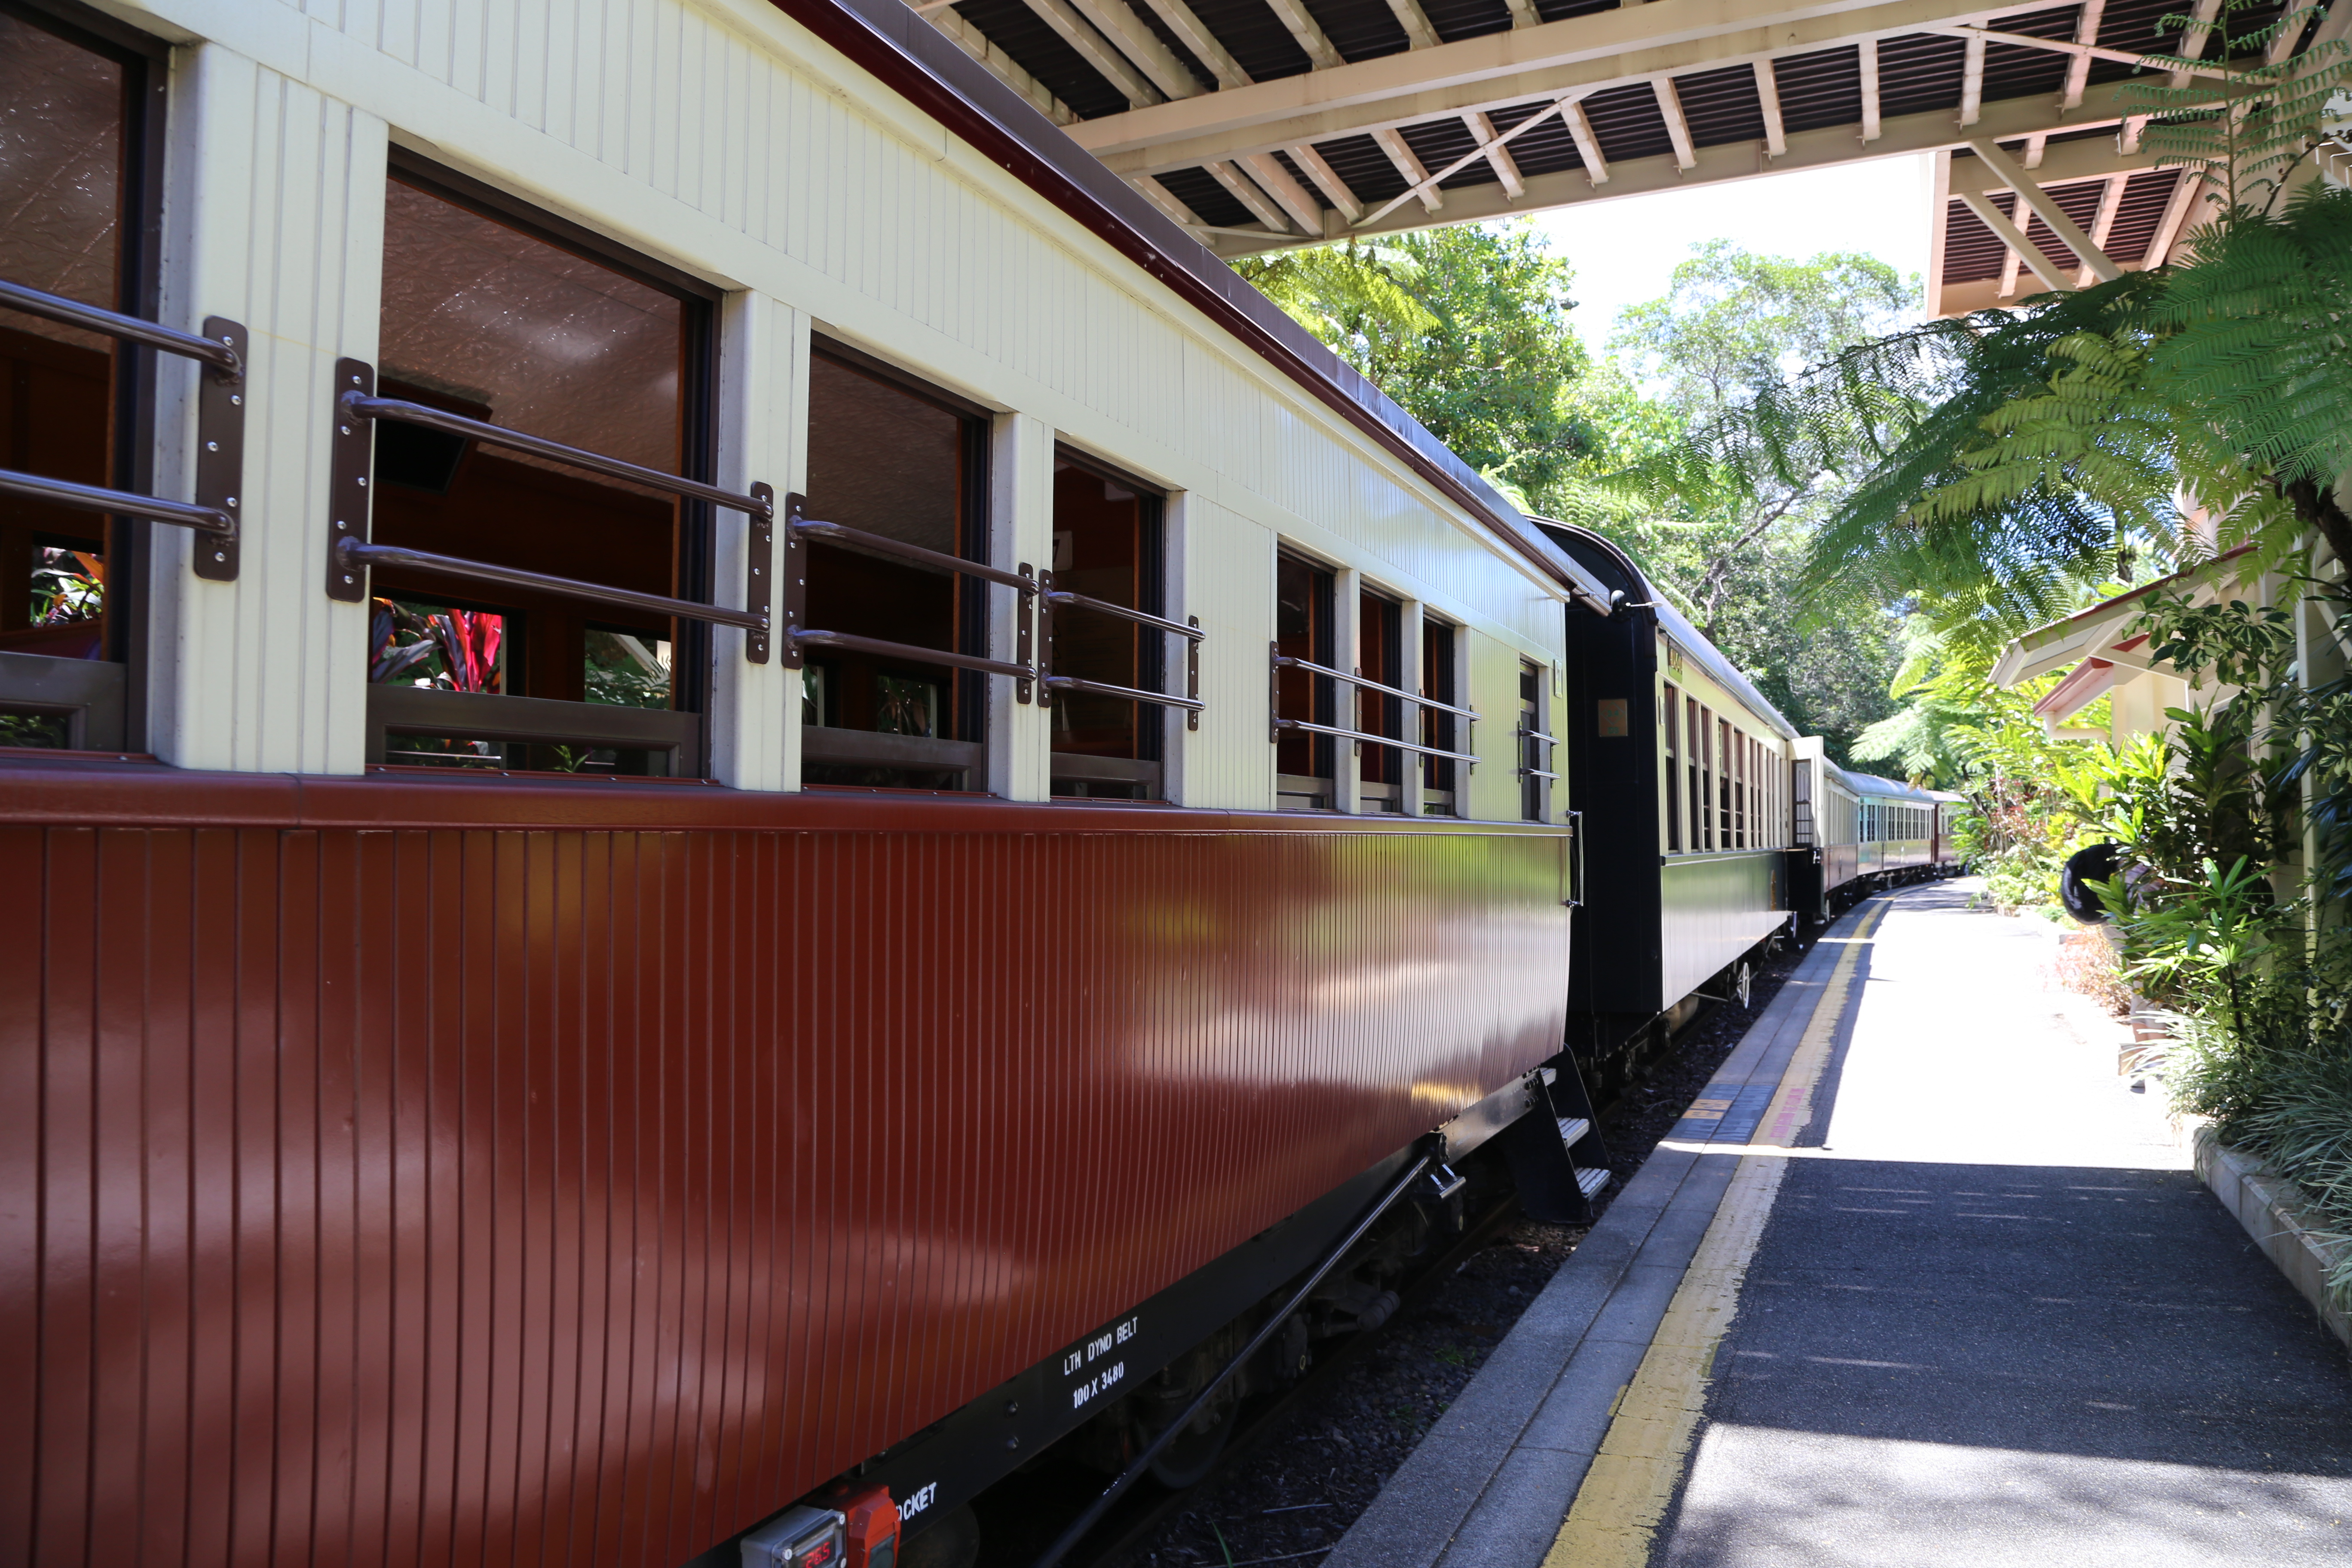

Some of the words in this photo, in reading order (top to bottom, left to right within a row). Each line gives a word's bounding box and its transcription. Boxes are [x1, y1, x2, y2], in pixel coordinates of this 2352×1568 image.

[1064, 1350, 1081, 1375] LTH
[1088, 1333, 1112, 1362] DYNO
[1117, 1316, 1137, 1344] BELT
[1073, 1384, 1090, 1409] 100
[1091, 1377, 1098, 1397] X
[1102, 1361, 1124, 1390] 3480
